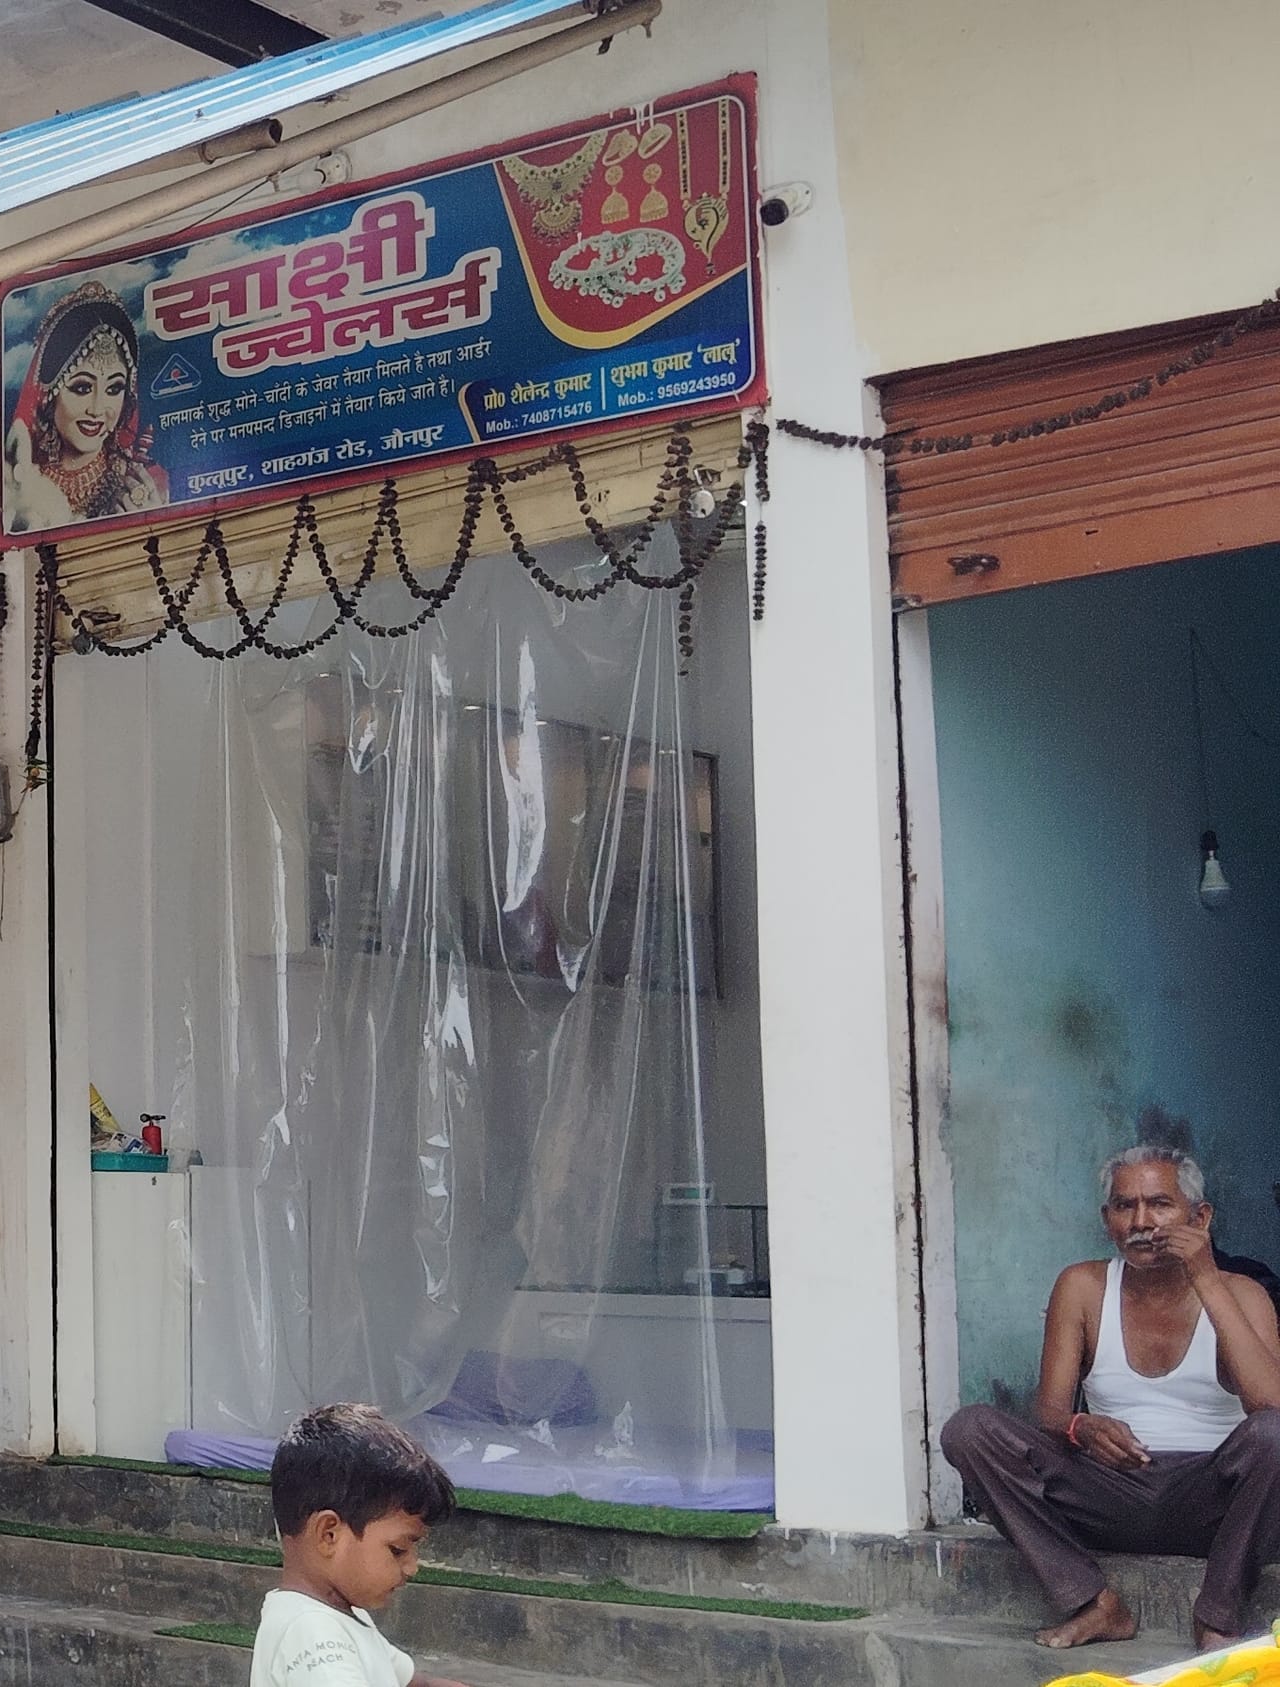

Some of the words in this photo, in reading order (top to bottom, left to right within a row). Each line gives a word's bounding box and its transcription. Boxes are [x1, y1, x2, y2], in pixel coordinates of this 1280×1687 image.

[152, 199, 425, 334] साक्षी
[221, 256, 491, 370] ज्वेलर्स
[159, 401, 205, 431] हालमार्क
[207, 397, 233, 423] शुद्ध
[294, 378, 310, 397] के
[311, 371, 339, 394] जेवर
[342, 365, 372, 387] तैयार
[376, 354, 412, 380] मिलते
[413, 350, 425, 372] है
[425, 350, 453, 370] तथा
[455, 337, 492, 361] आर्डर
[510, 380, 551, 406] शैलेन्द्र
[554, 373, 593, 400] कुमार
[609, 360, 648, 385] शुभम
[652, 351, 693, 379] कुमार
[657, 371, 736, 400] 9569243950
[190, 429, 208, 451] देने
[210, 426, 226, 443] पर
[228, 416, 277, 441] मनपसन्द
[278, 400, 328, 431] डिजाइनों
[330, 397, 343, 418] में
[344, 393, 375, 416] तैयार
[377, 384, 406, 409] किये
[409, 380, 437, 404] जाते
[521, 401, 593, 427] 7408715476
[261, 444, 329, 475] शाहगंज
[380, 423, 445, 450] जौनपुर
